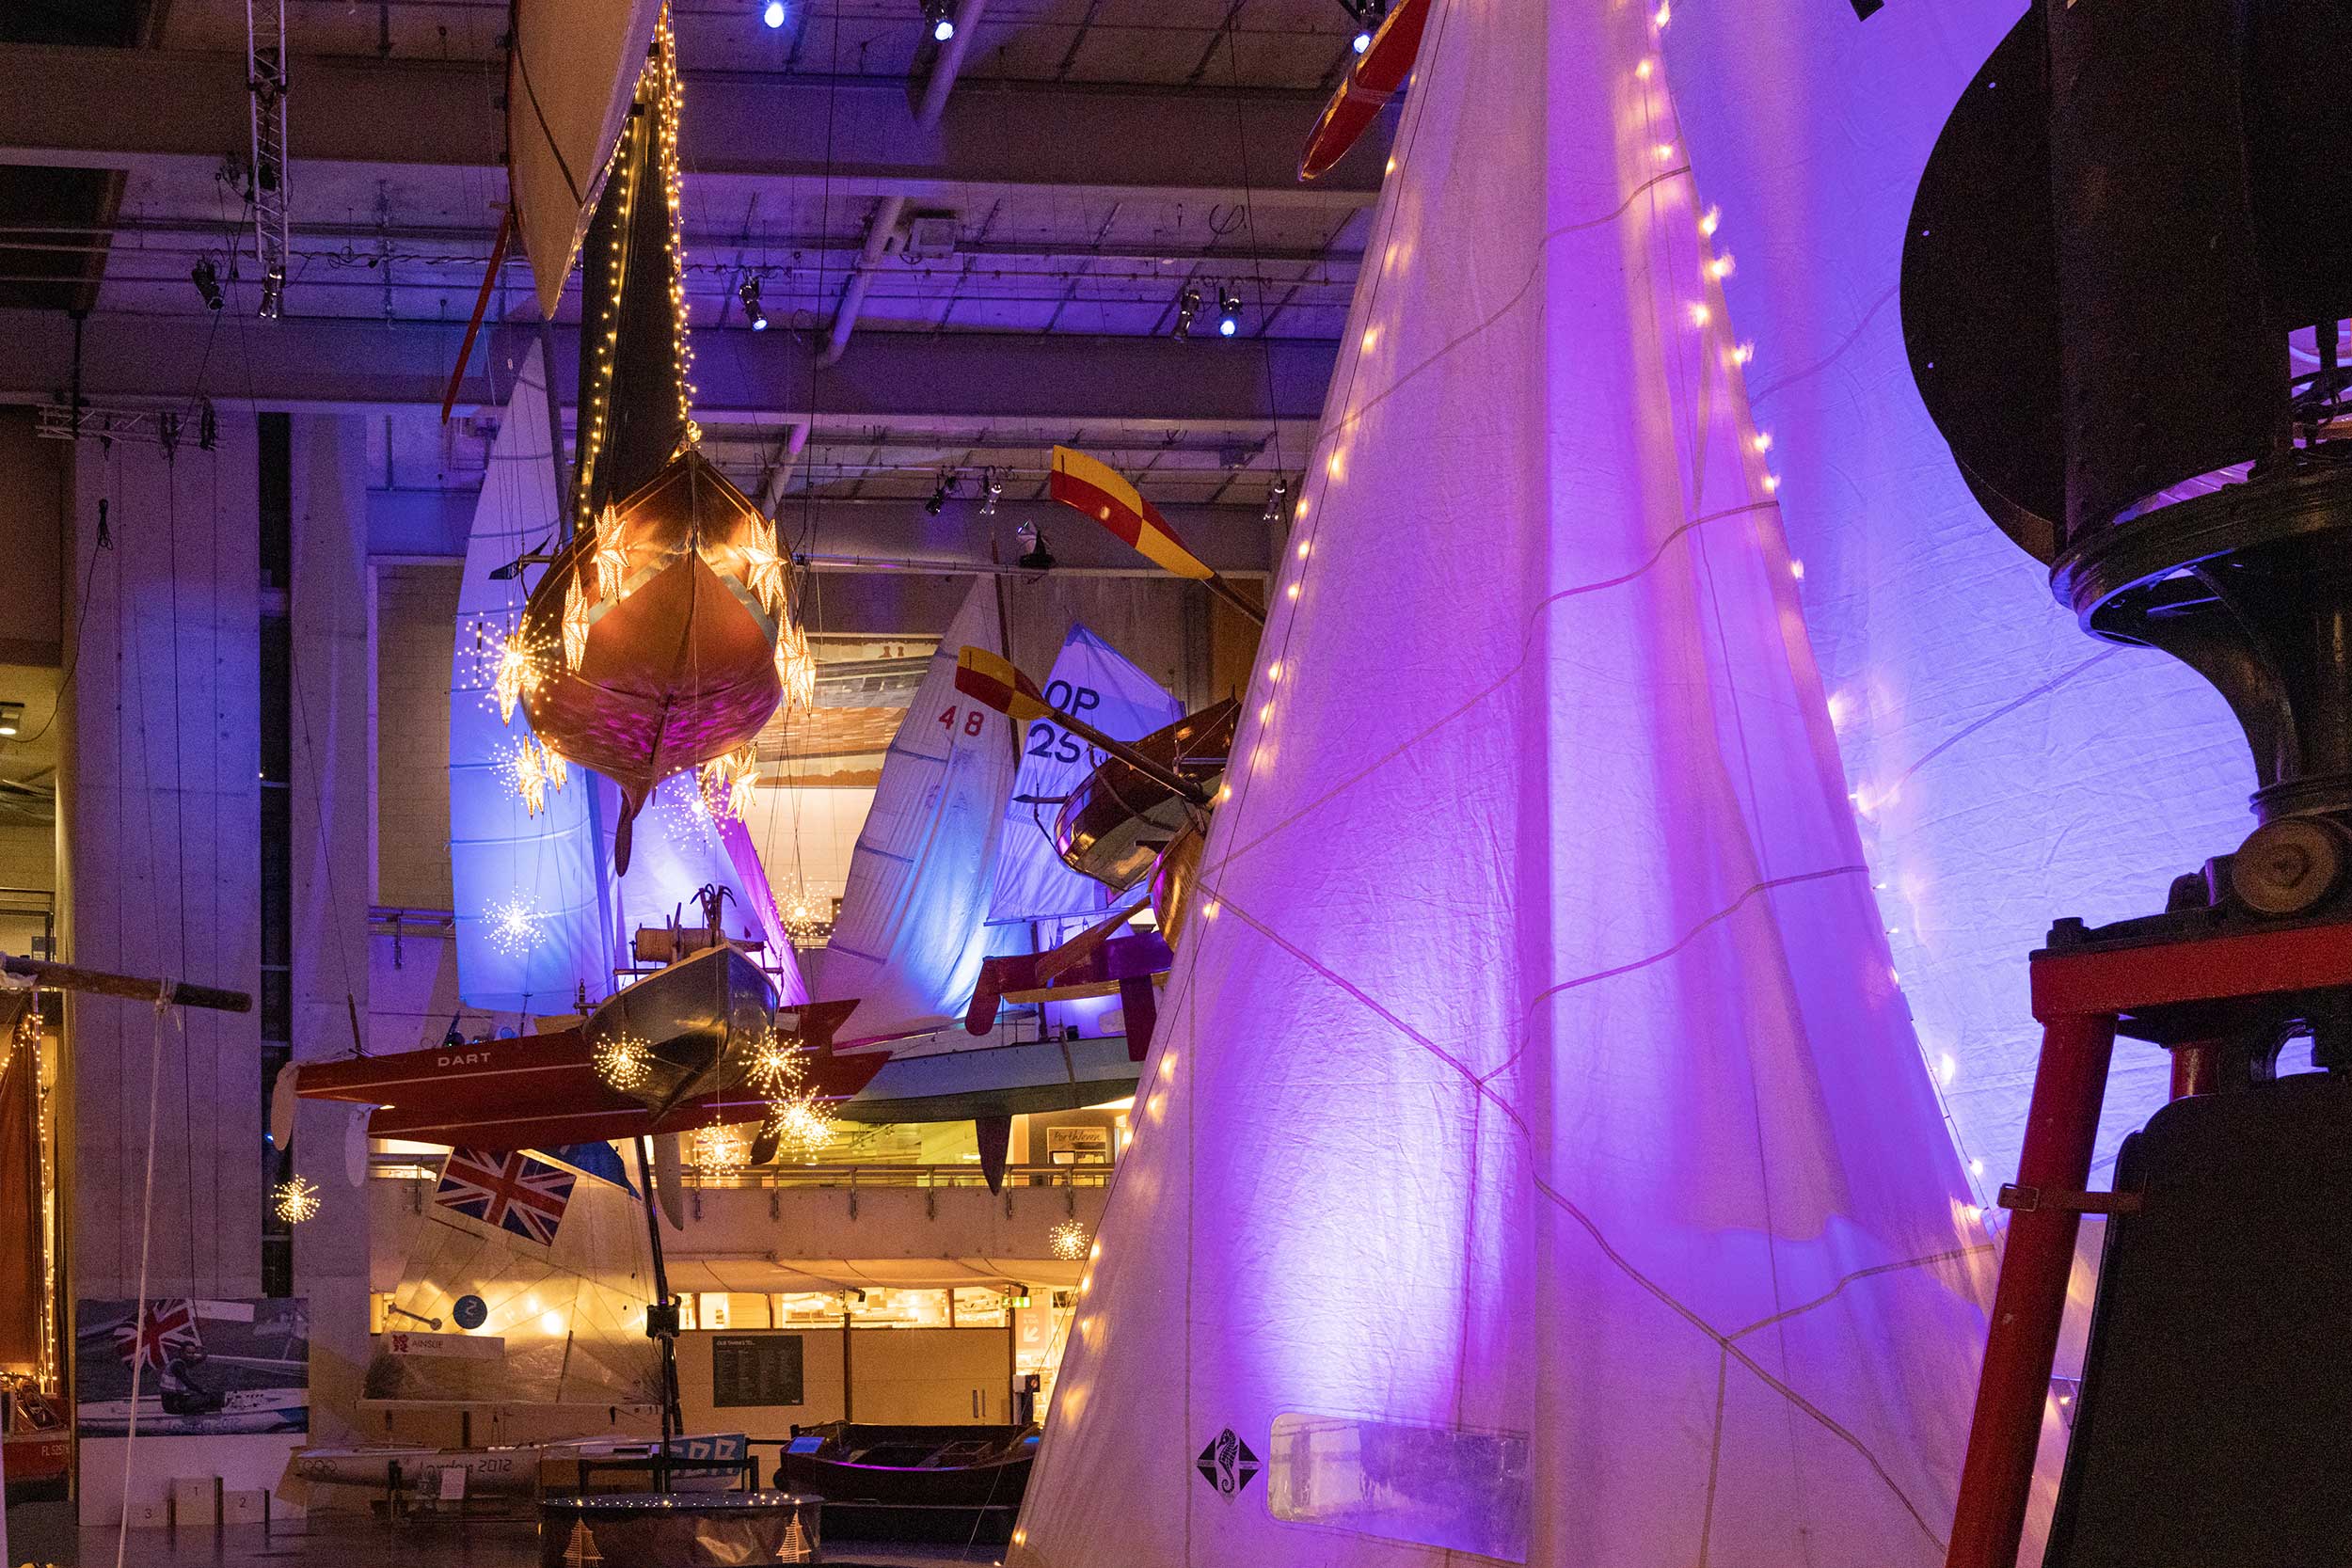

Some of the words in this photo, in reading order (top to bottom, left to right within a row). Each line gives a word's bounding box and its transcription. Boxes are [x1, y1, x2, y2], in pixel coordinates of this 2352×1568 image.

[1044, 679, 1100, 717] OP
[1026, 722, 1109, 764] 25
[437, 1053, 491, 1067] DART
[478, 1459, 512, 1473] 2012
[193, 1486, 199, 1497] 1
[239, 1497, 246, 1508] 2
[144, 1509, 152, 1519] 3
